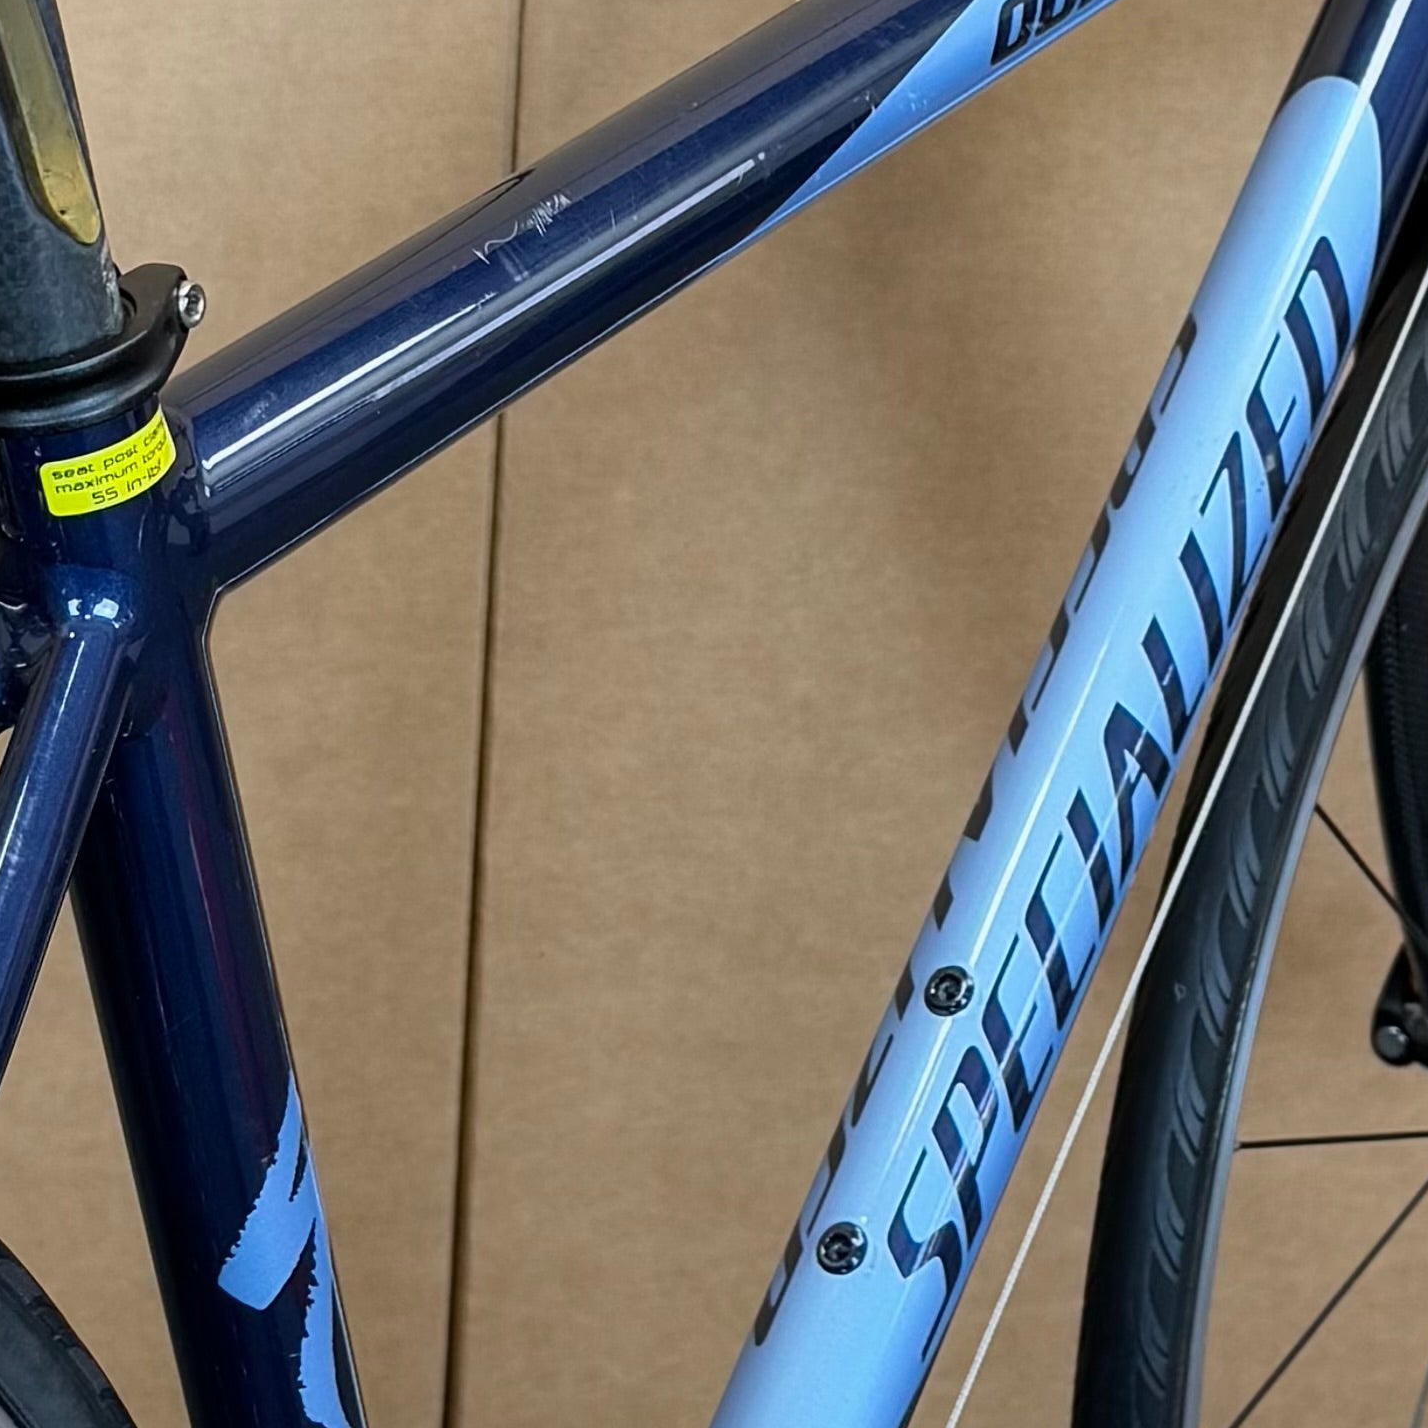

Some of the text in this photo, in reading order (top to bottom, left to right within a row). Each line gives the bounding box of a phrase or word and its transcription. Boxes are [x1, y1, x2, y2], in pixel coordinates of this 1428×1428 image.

[51, 463, 95, 481] seat
[103, 443, 139, 471] post
[55, 462, 138, 494] maximum
[91, 486, 119, 505] 55
